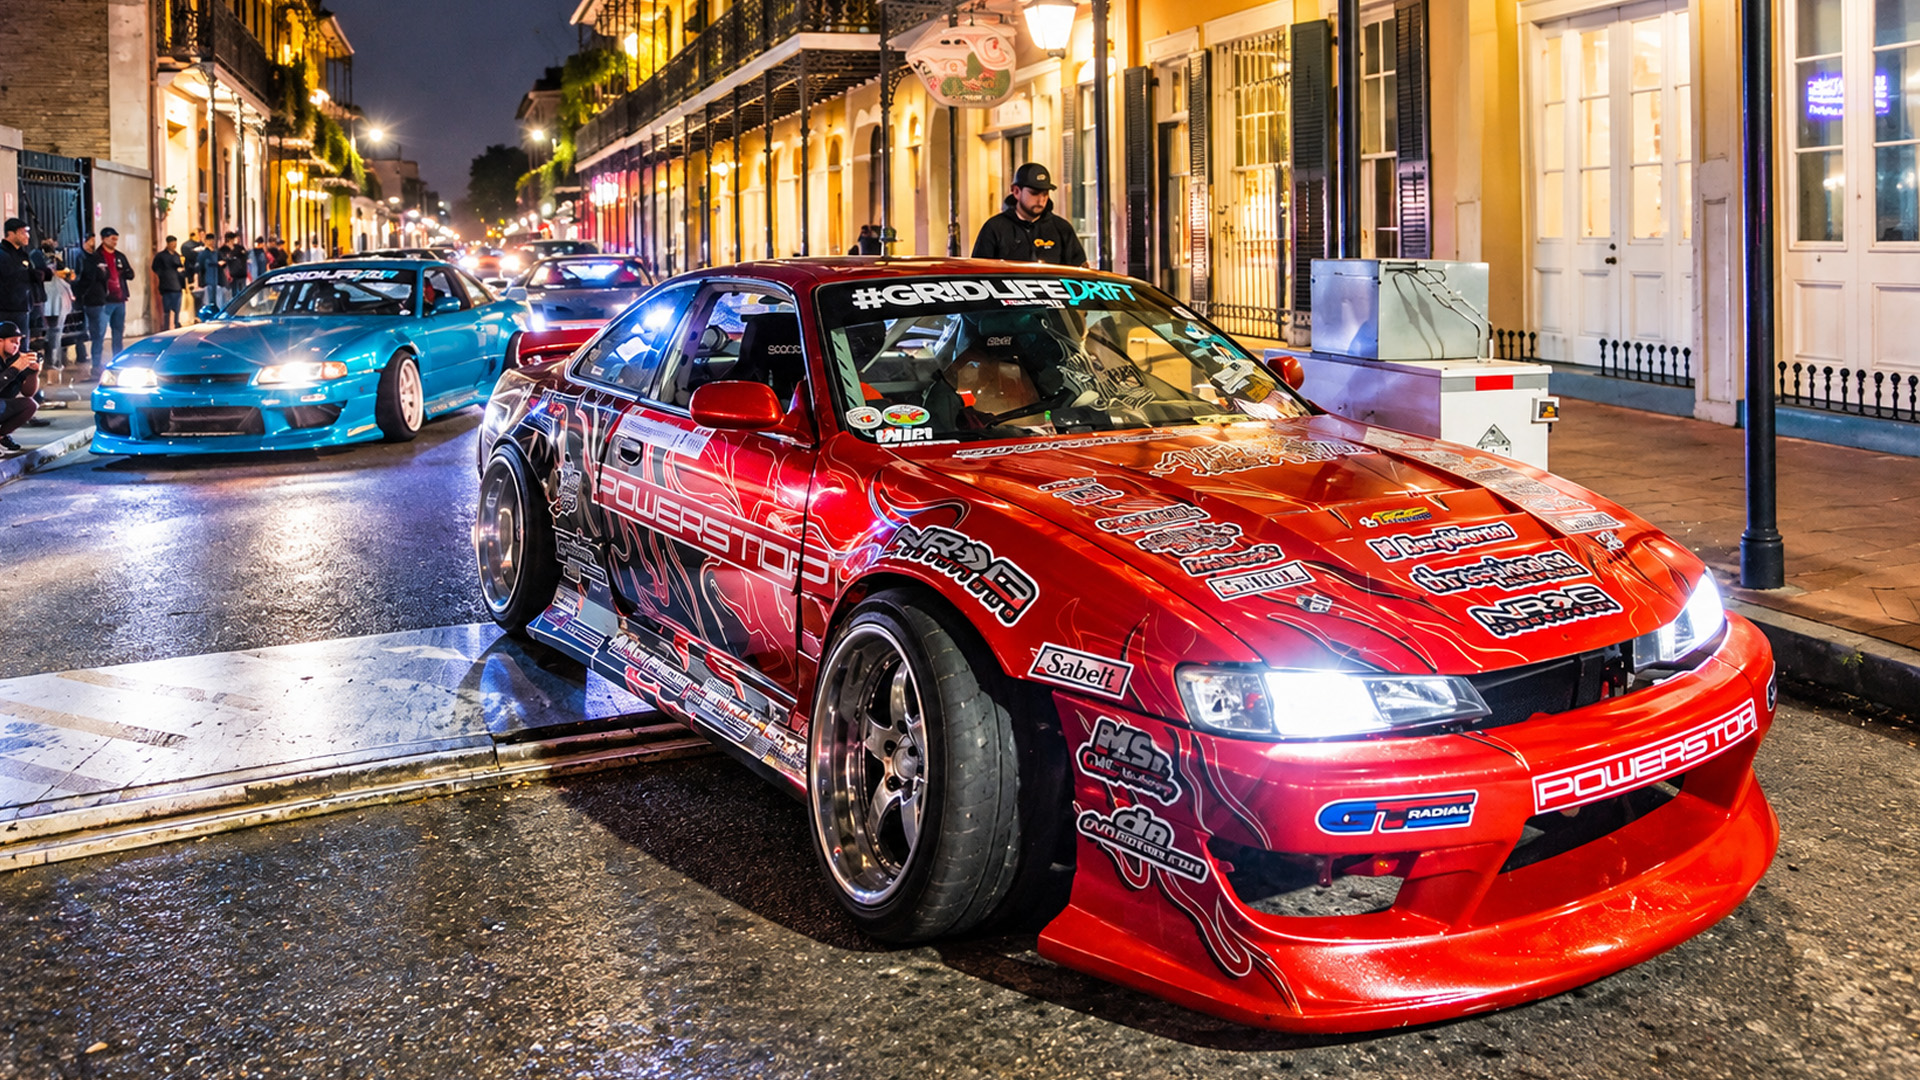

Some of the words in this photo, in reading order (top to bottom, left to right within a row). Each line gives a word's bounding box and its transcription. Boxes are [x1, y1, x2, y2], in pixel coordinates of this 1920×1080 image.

[599, 470, 829, 585] POWERSTOP
[1045, 652, 1116, 688] Sabelt
[1538, 704, 1754, 807] POWERSTOP
[1407, 803, 1471, 819] RADIAL
